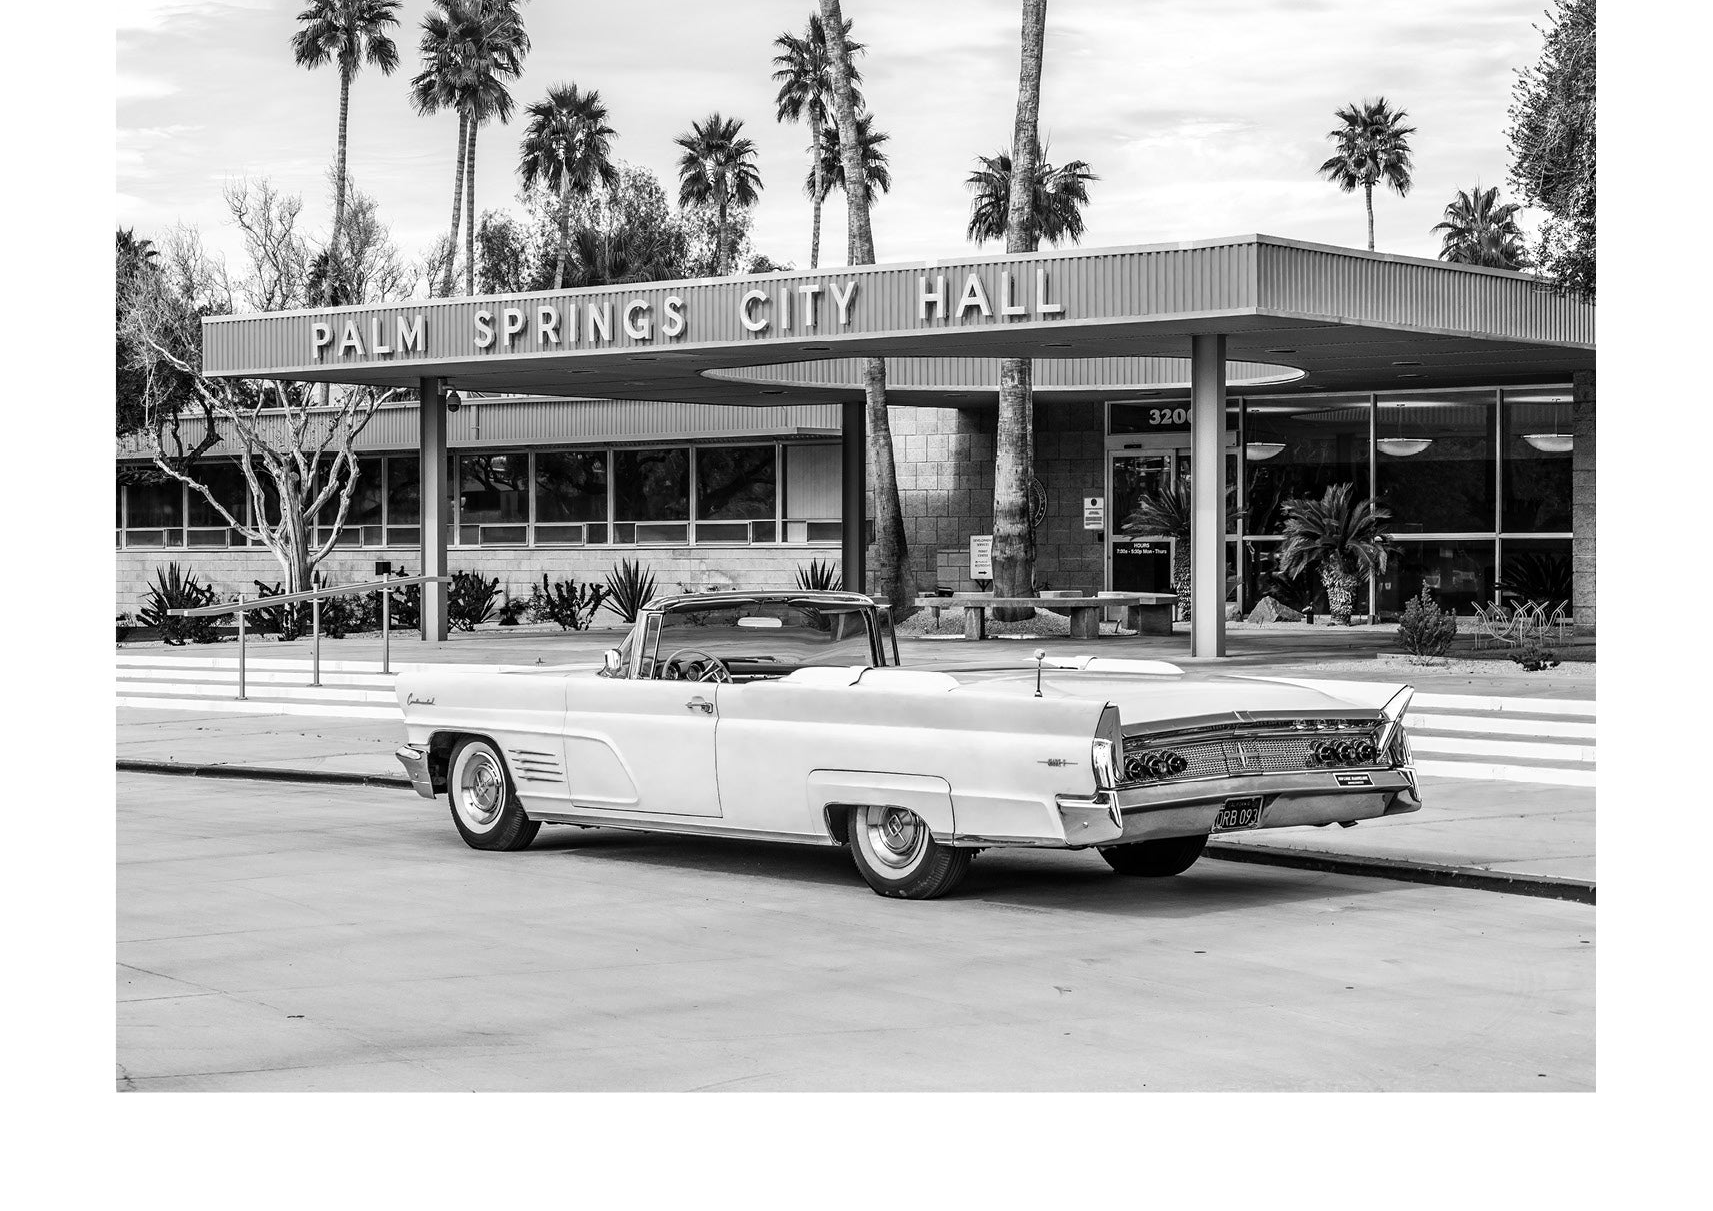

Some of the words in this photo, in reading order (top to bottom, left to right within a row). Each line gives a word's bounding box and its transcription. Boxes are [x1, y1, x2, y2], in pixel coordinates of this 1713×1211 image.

[311, 314, 428, 358] PALM
[474, 296, 687, 347] SPRINGS
[739, 280, 859, 331] CITY
[918, 269, 1064, 320] HALL
[1239, 808, 1258, 825] 093
